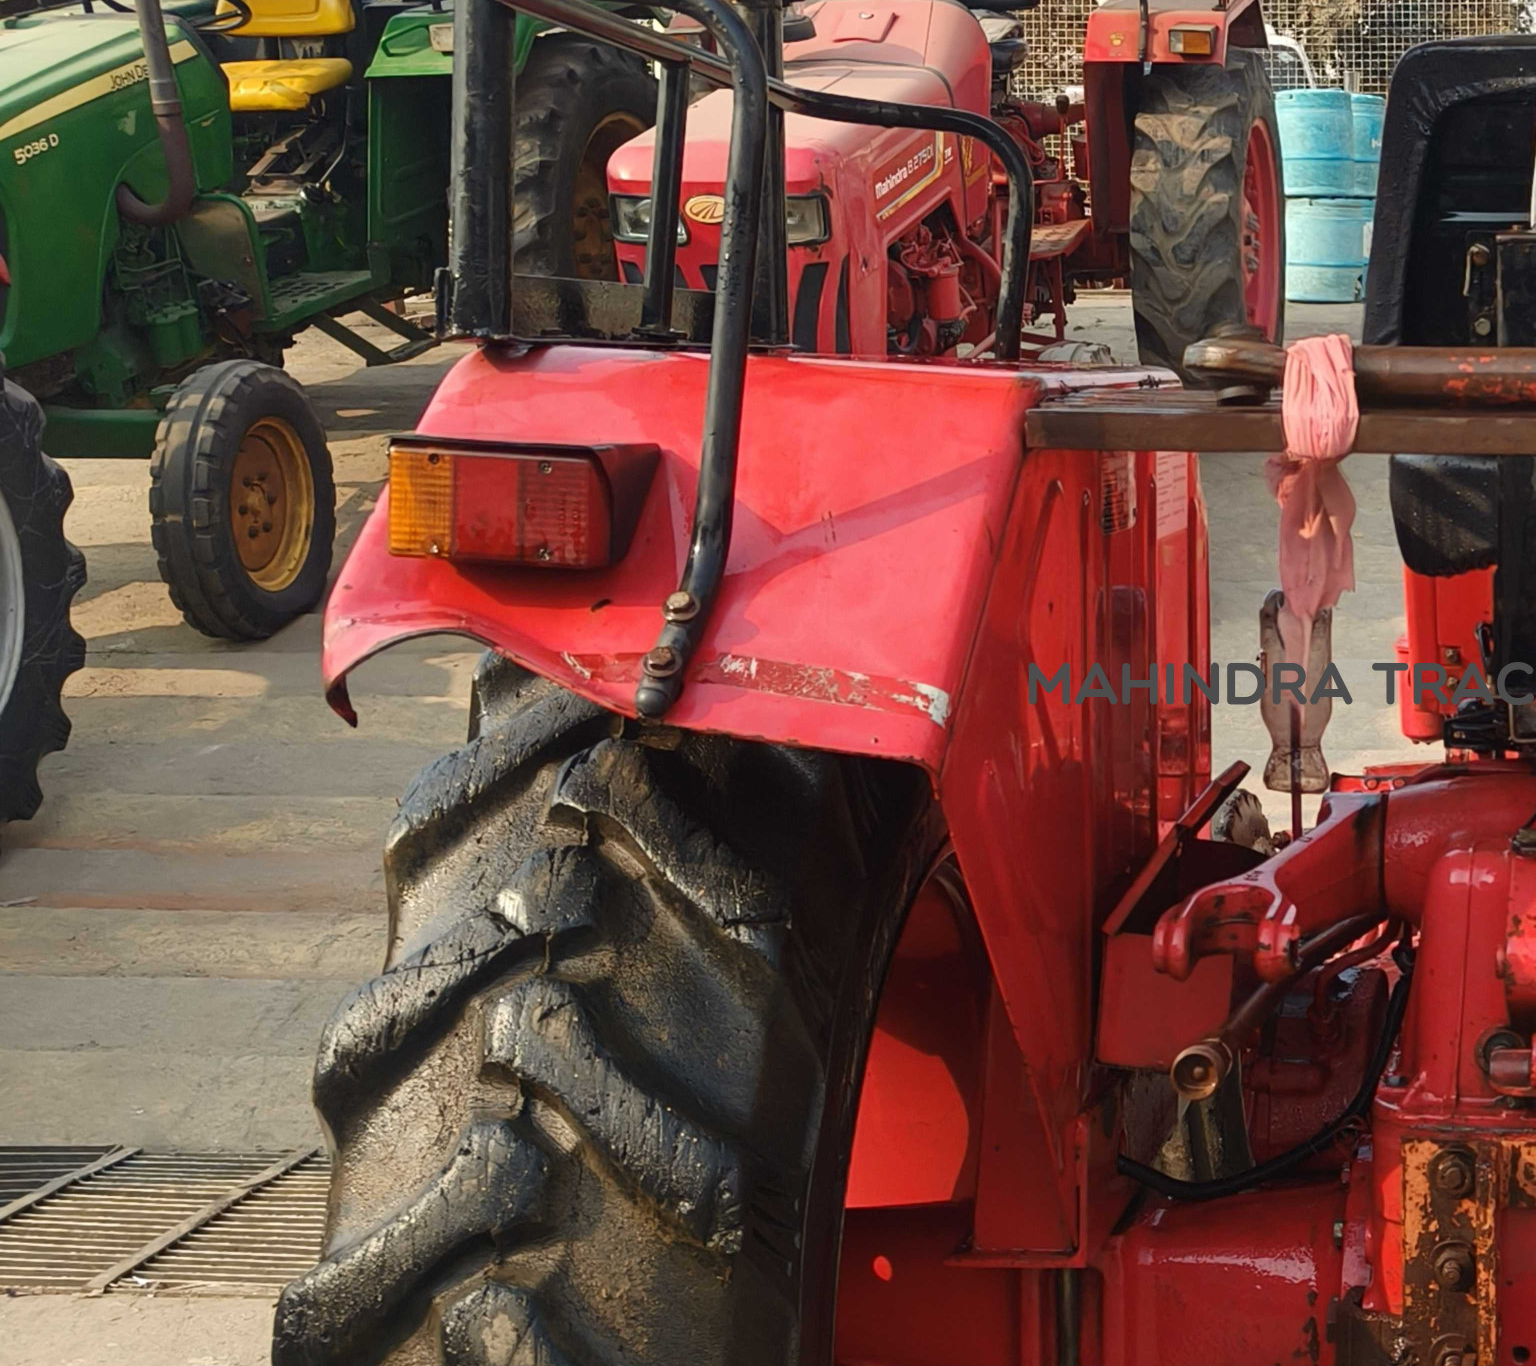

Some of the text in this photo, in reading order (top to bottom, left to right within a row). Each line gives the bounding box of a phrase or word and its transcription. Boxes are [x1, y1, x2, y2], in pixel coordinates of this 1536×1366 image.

[110, 68, 135, 90] JOHN
[14, 133, 59, 165] 5036 D
[875, 166, 908, 199] Mahindra
